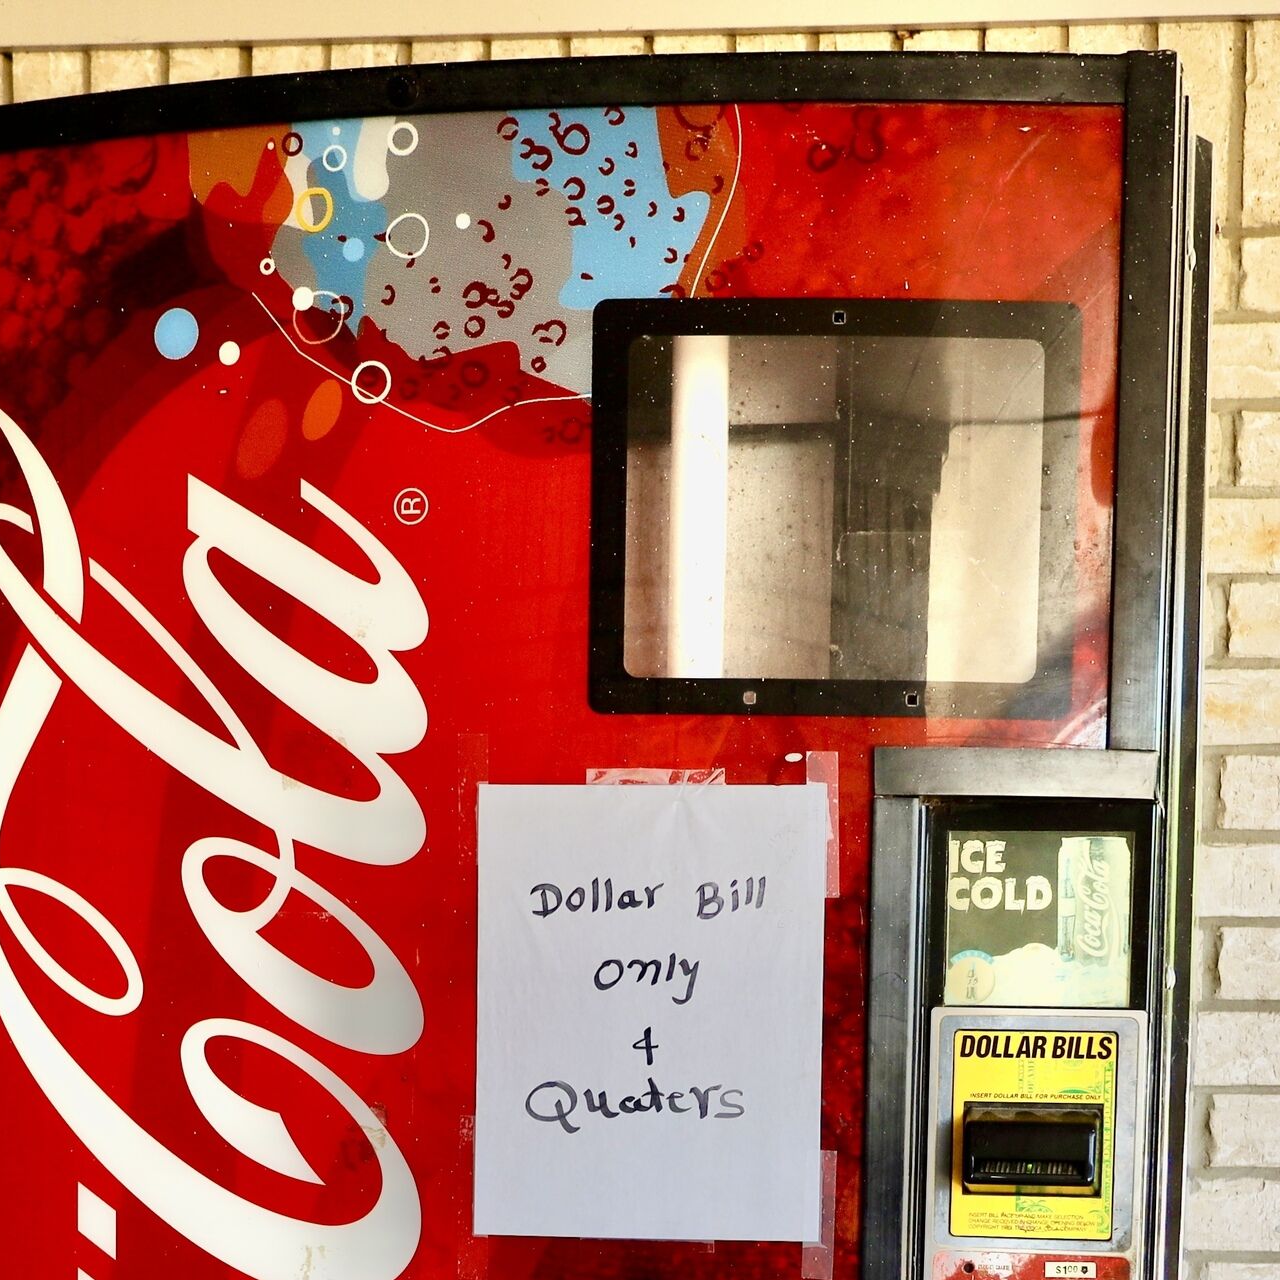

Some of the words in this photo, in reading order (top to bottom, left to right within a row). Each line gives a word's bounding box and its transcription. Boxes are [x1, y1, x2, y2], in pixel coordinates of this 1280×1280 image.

[949, 839, 1007, 874] ICE
[530, 876, 664, 919] Dollar
[696, 876, 768, 920] Bill
[948, 875, 1053, 915] COLD
[959, 1035, 1048, 1058] DOLLAR
[1051, 1036, 1113, 1060] BILLS
[525, 1078, 746, 1134] Quaters
